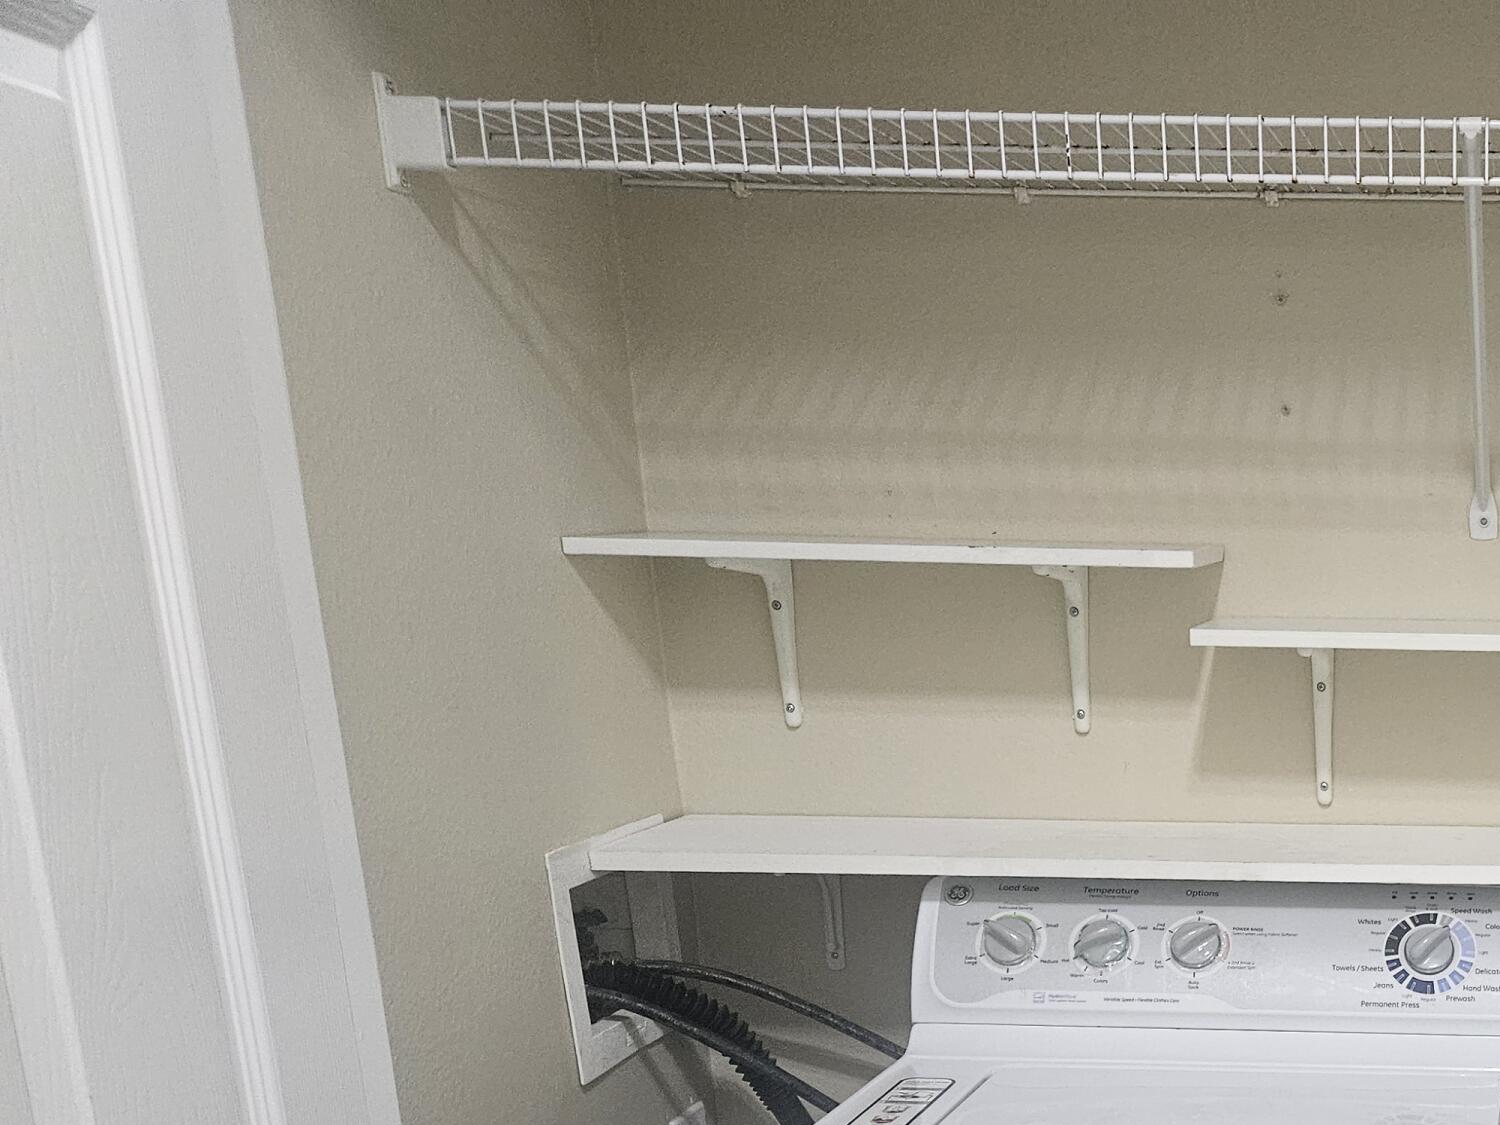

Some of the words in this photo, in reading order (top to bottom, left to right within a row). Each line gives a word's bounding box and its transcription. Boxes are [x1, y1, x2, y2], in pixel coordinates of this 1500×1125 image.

[998, 884, 1020, 892] Load
[1083, 886, 1140, 896] Temperature
[1186, 889, 1219, 898] Options
